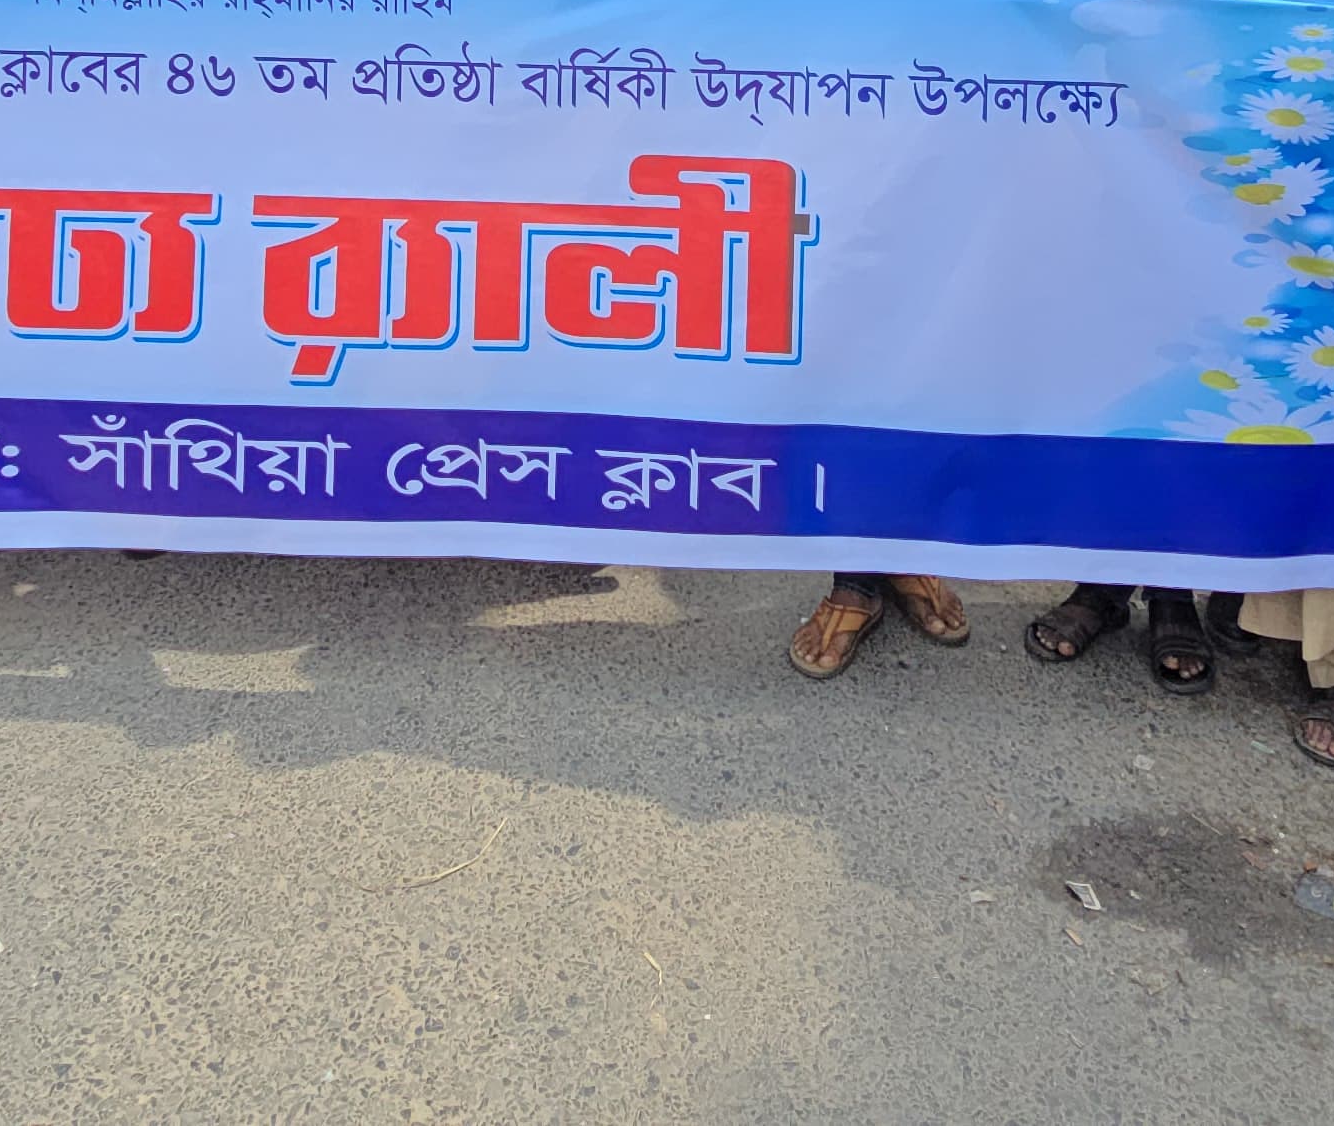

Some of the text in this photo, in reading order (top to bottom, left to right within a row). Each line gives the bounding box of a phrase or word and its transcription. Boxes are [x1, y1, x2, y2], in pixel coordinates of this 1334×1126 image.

[166, 55, 235, 100] ৪৬
[252, 55, 337, 102] তম
[352, 40, 504, 108] প্রতিষ্ঠা
[518, 46, 676, 112] বার্ষিকী
[908, 58, 1129, 128] উপলক্ষ্যে
[59, 414, 351, 498] সাঁথিয়া
[386, 437, 573, 501] প্রেস
[596, 448, 778, 513] ক্লাব
